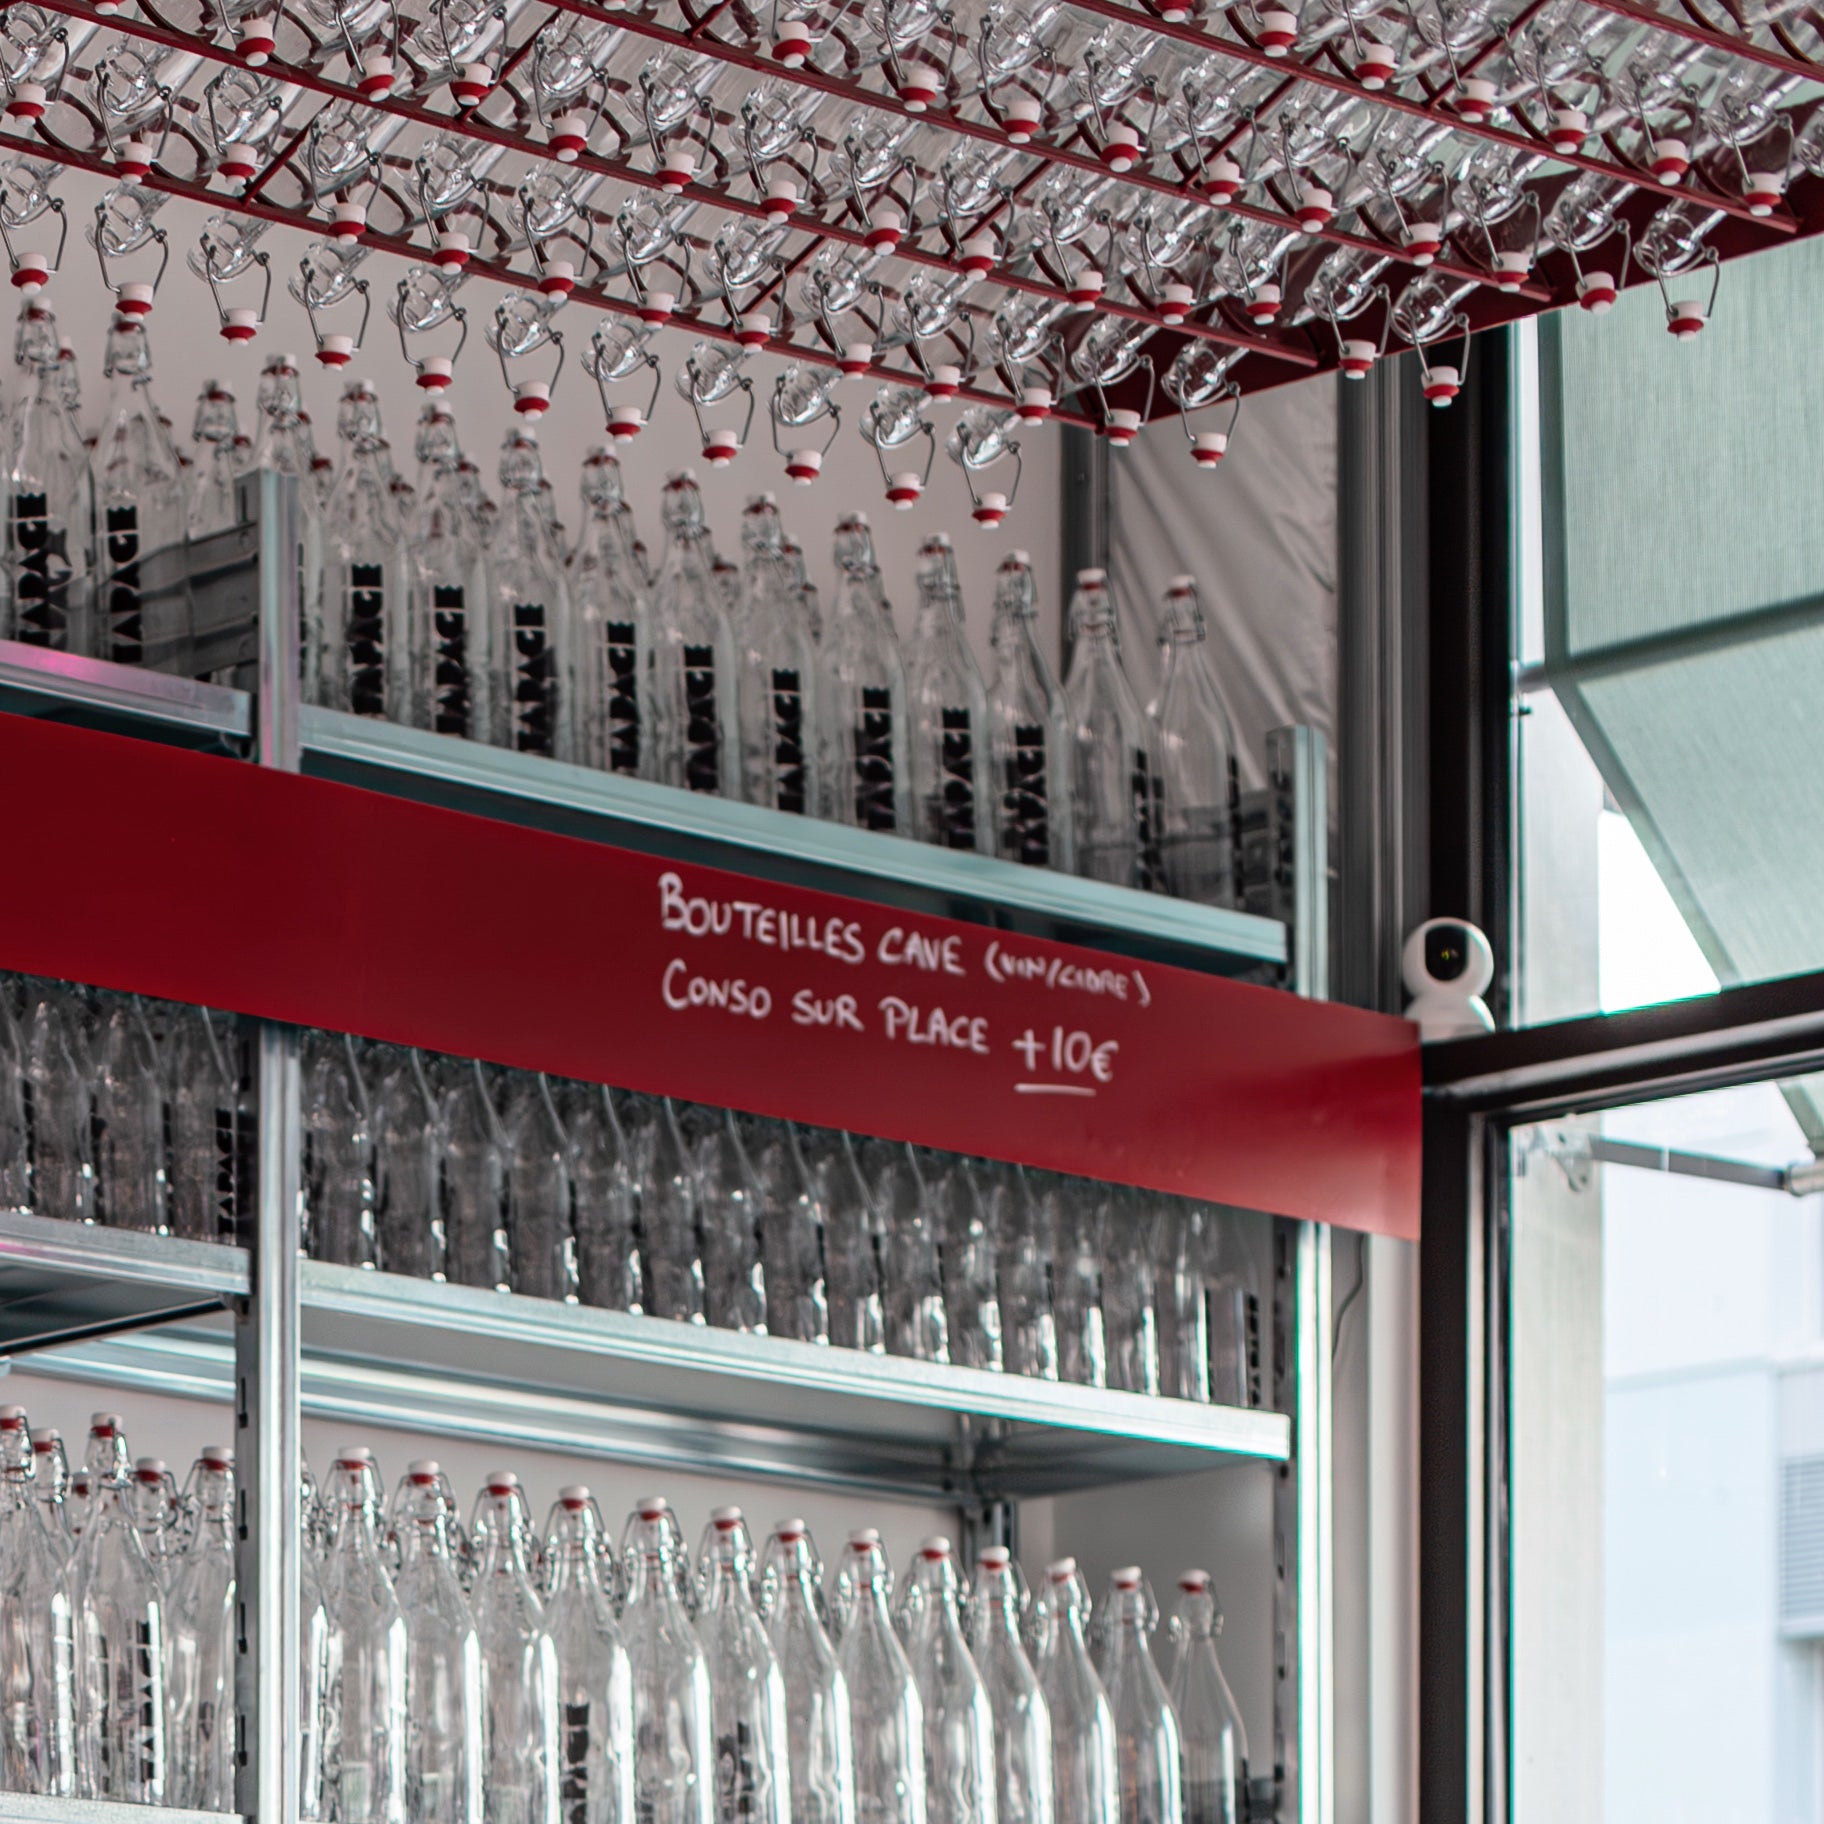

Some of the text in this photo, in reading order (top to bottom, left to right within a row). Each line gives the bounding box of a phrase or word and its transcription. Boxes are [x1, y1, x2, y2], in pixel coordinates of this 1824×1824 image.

[659, 872, 865, 964] BOUTEILLES
[877, 928, 966, 975] CAVE
[792, 989, 864, 1032] SUR
[879, 996, 990, 1054] PLACE
[1013, 1026, 1119, 1082] +10€
